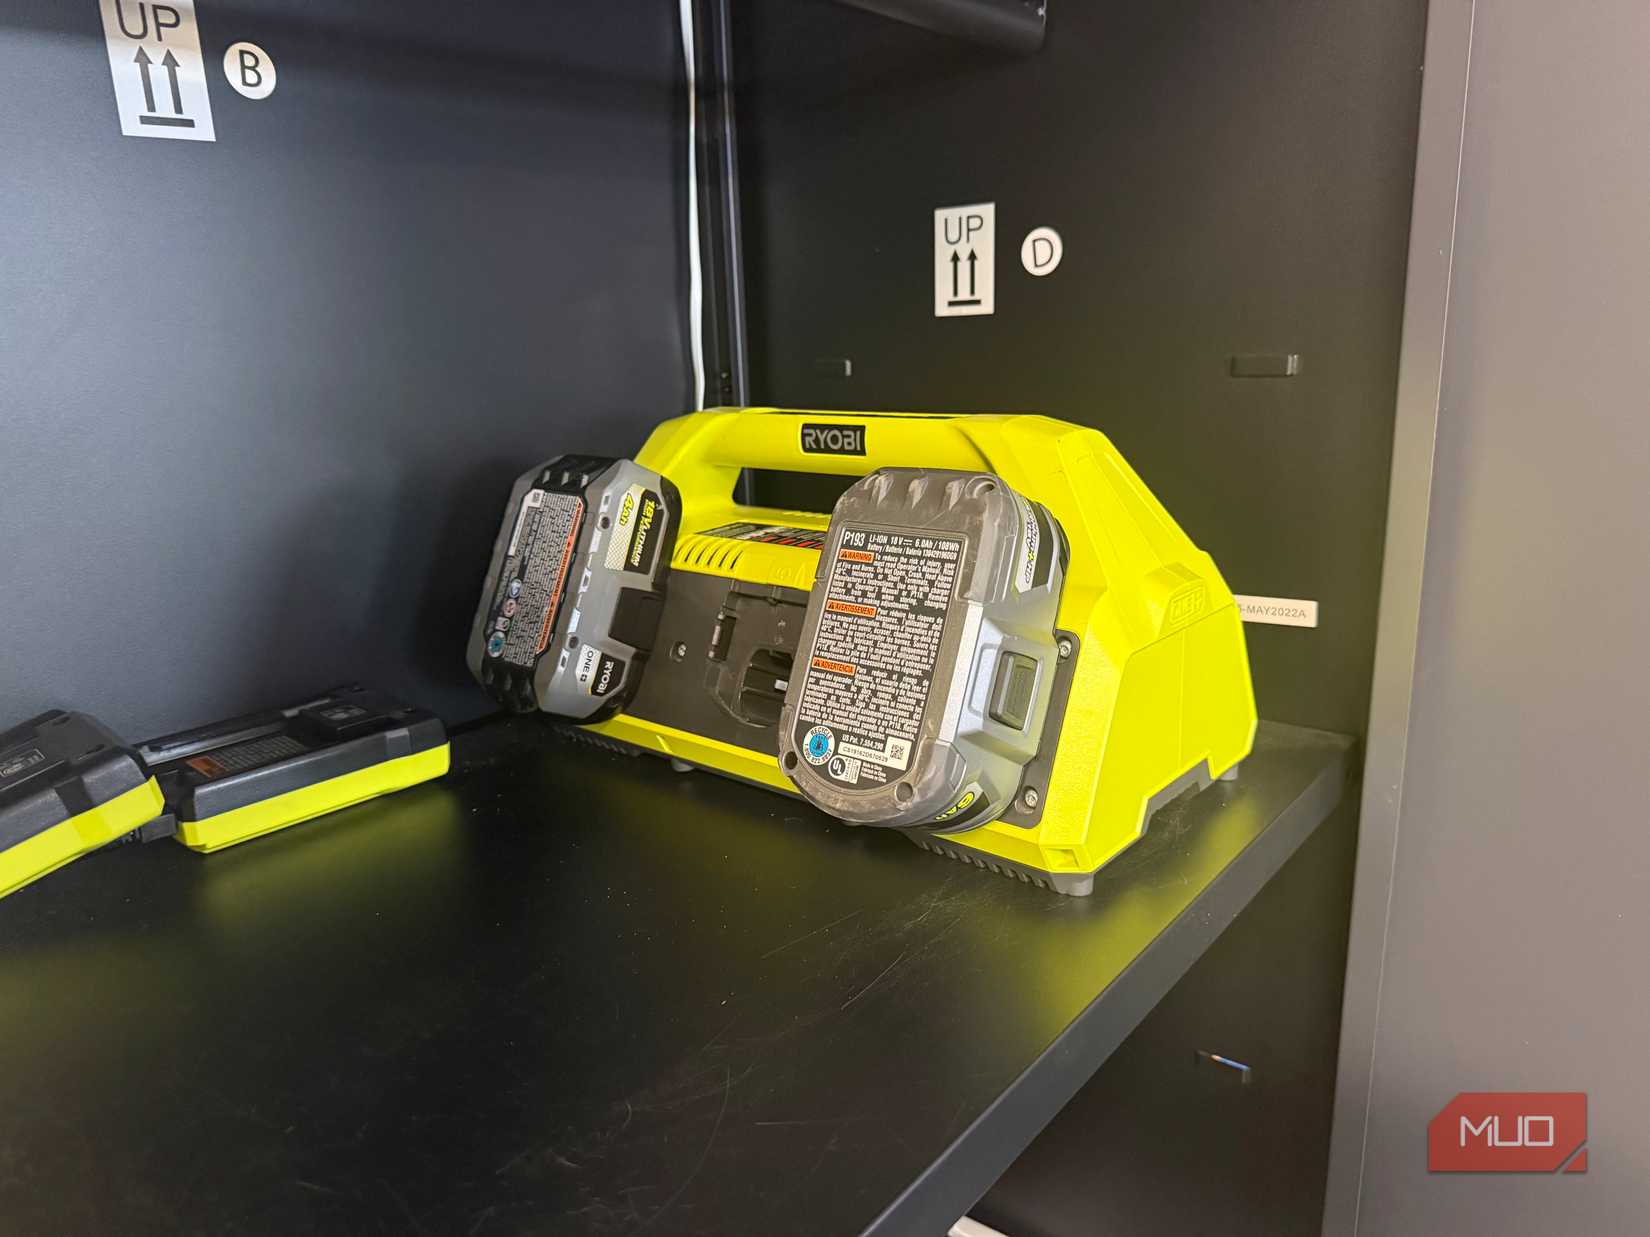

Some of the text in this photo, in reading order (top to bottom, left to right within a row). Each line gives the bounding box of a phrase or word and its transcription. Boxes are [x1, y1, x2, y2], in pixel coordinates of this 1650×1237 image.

[114, 0, 181, 42] UP
[239, 49, 262, 88] B
[944, 215, 983, 245] UP
[1033, 238, 1054, 268] D
[803, 428, 861, 450] RYOBI
[619, 492, 634, 526] 4Ah
[843, 531, 866, 547] P193
[869, 534, 888, 543] LI-ION
[847, 552, 872, 561] WARNING
[596, 661, 614, 693] RYOBI
